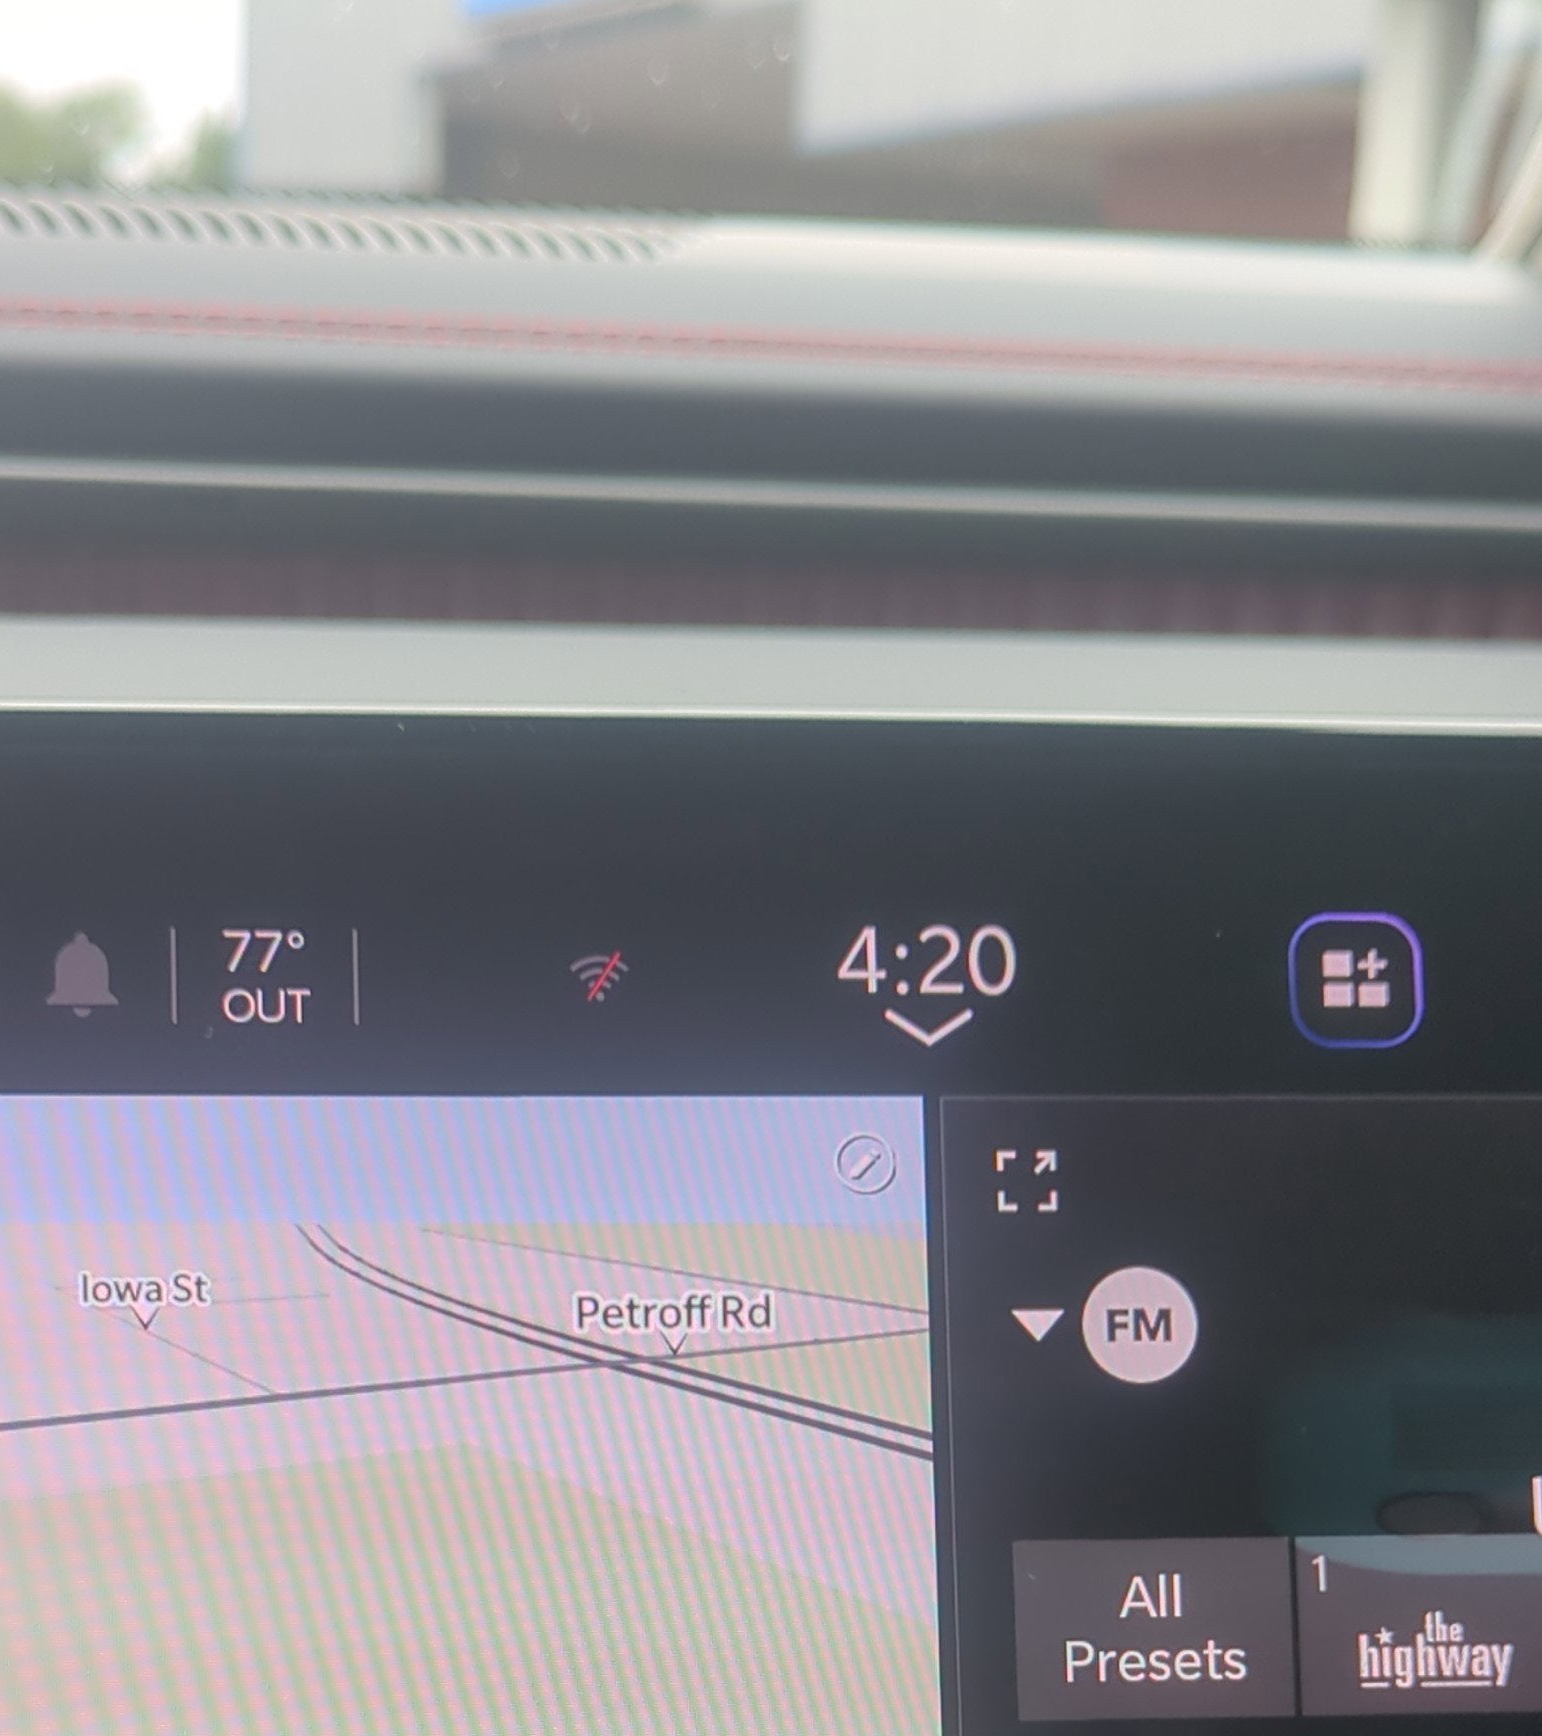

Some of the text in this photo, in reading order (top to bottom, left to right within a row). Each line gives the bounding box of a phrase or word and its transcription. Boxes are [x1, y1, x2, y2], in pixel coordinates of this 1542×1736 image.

[221, 929, 306, 974] 77°
[837, 924, 1017, 997] 4:20
[221, 987, 312, 1025] OUT
[79, 1272, 209, 1305] Iowa St
[575, 1296, 773, 1332] Petroff Rd
[1105, 1308, 1174, 1343] FM
[1311, 1553, 1329, 1594] 1
[1119, 1574, 1183, 1619] All
[1424, 1609, 1465, 1643] the
[1065, 1640, 1247, 1683] Presets
[1358, 1632, 1515, 1689] highway
